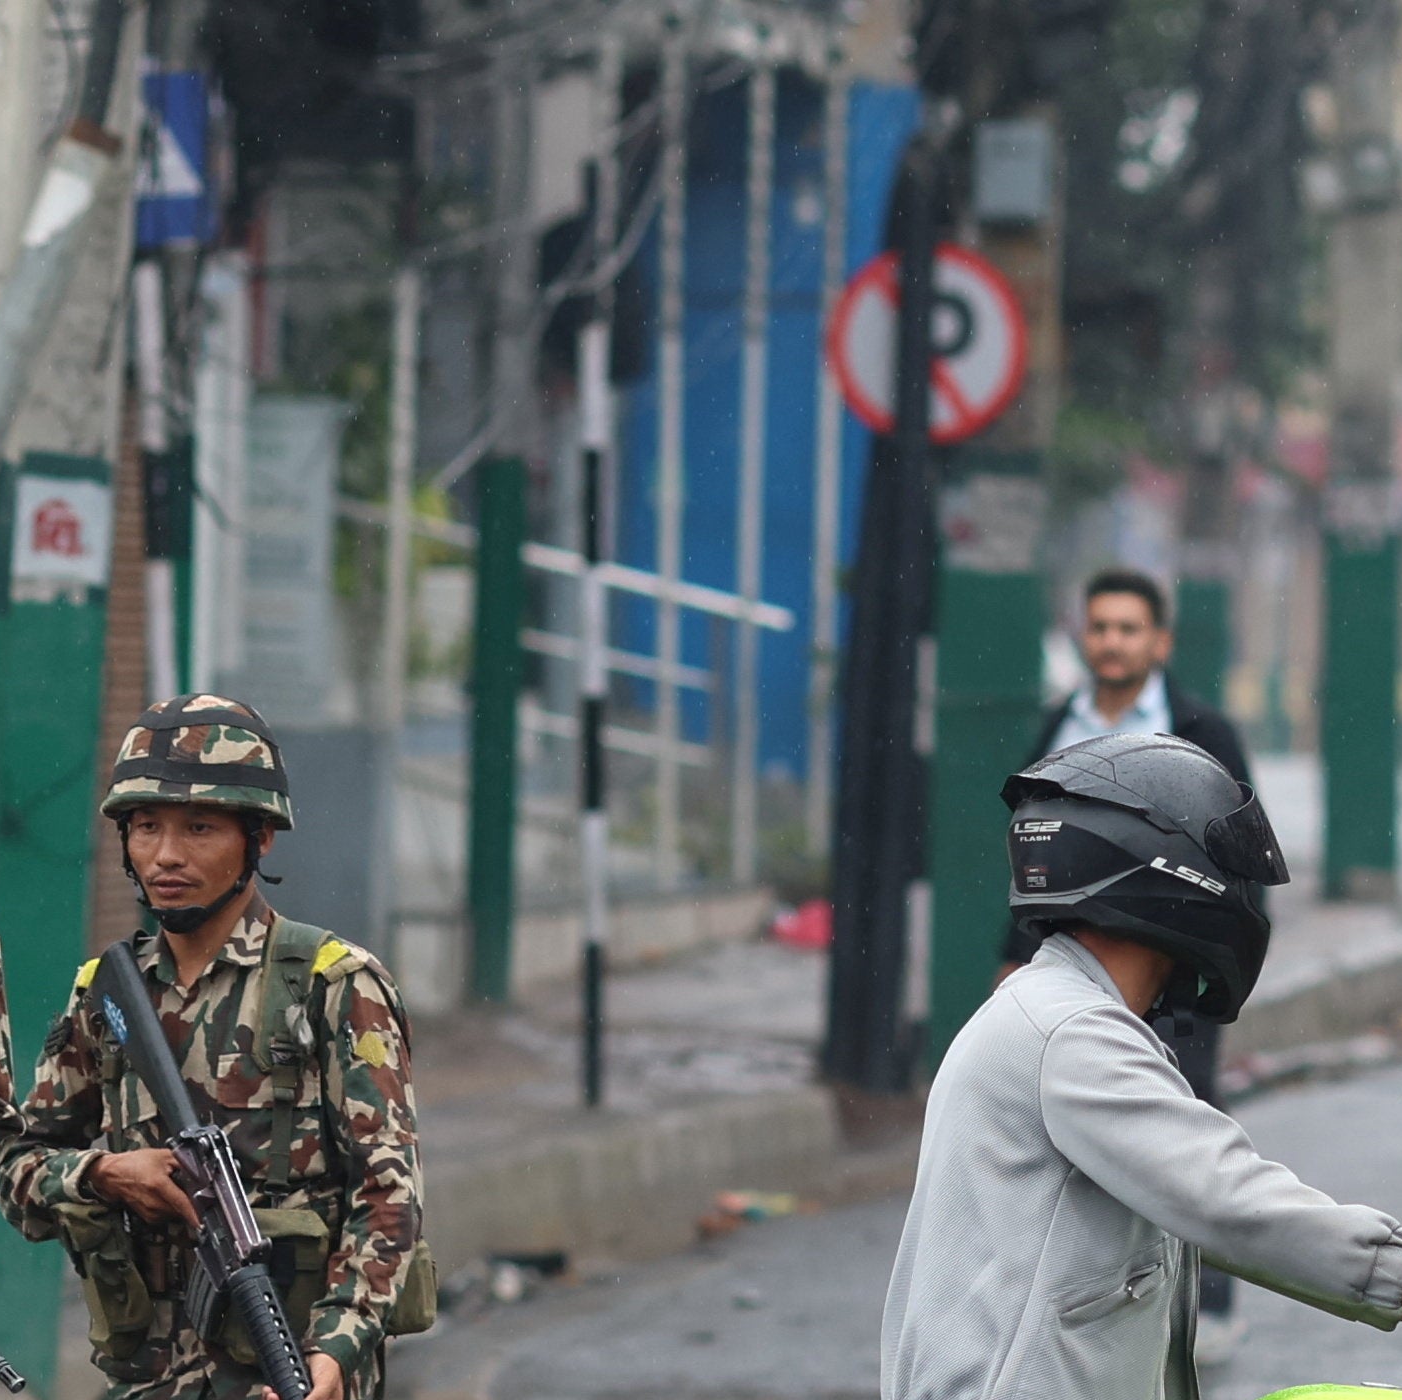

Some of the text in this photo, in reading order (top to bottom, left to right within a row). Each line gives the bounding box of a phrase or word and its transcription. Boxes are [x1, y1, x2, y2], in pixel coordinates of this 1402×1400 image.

[1014, 820, 1063, 834] LS2
[1019, 834, 1052, 843] FLASH
[1150, 856, 1227, 896] LS2
